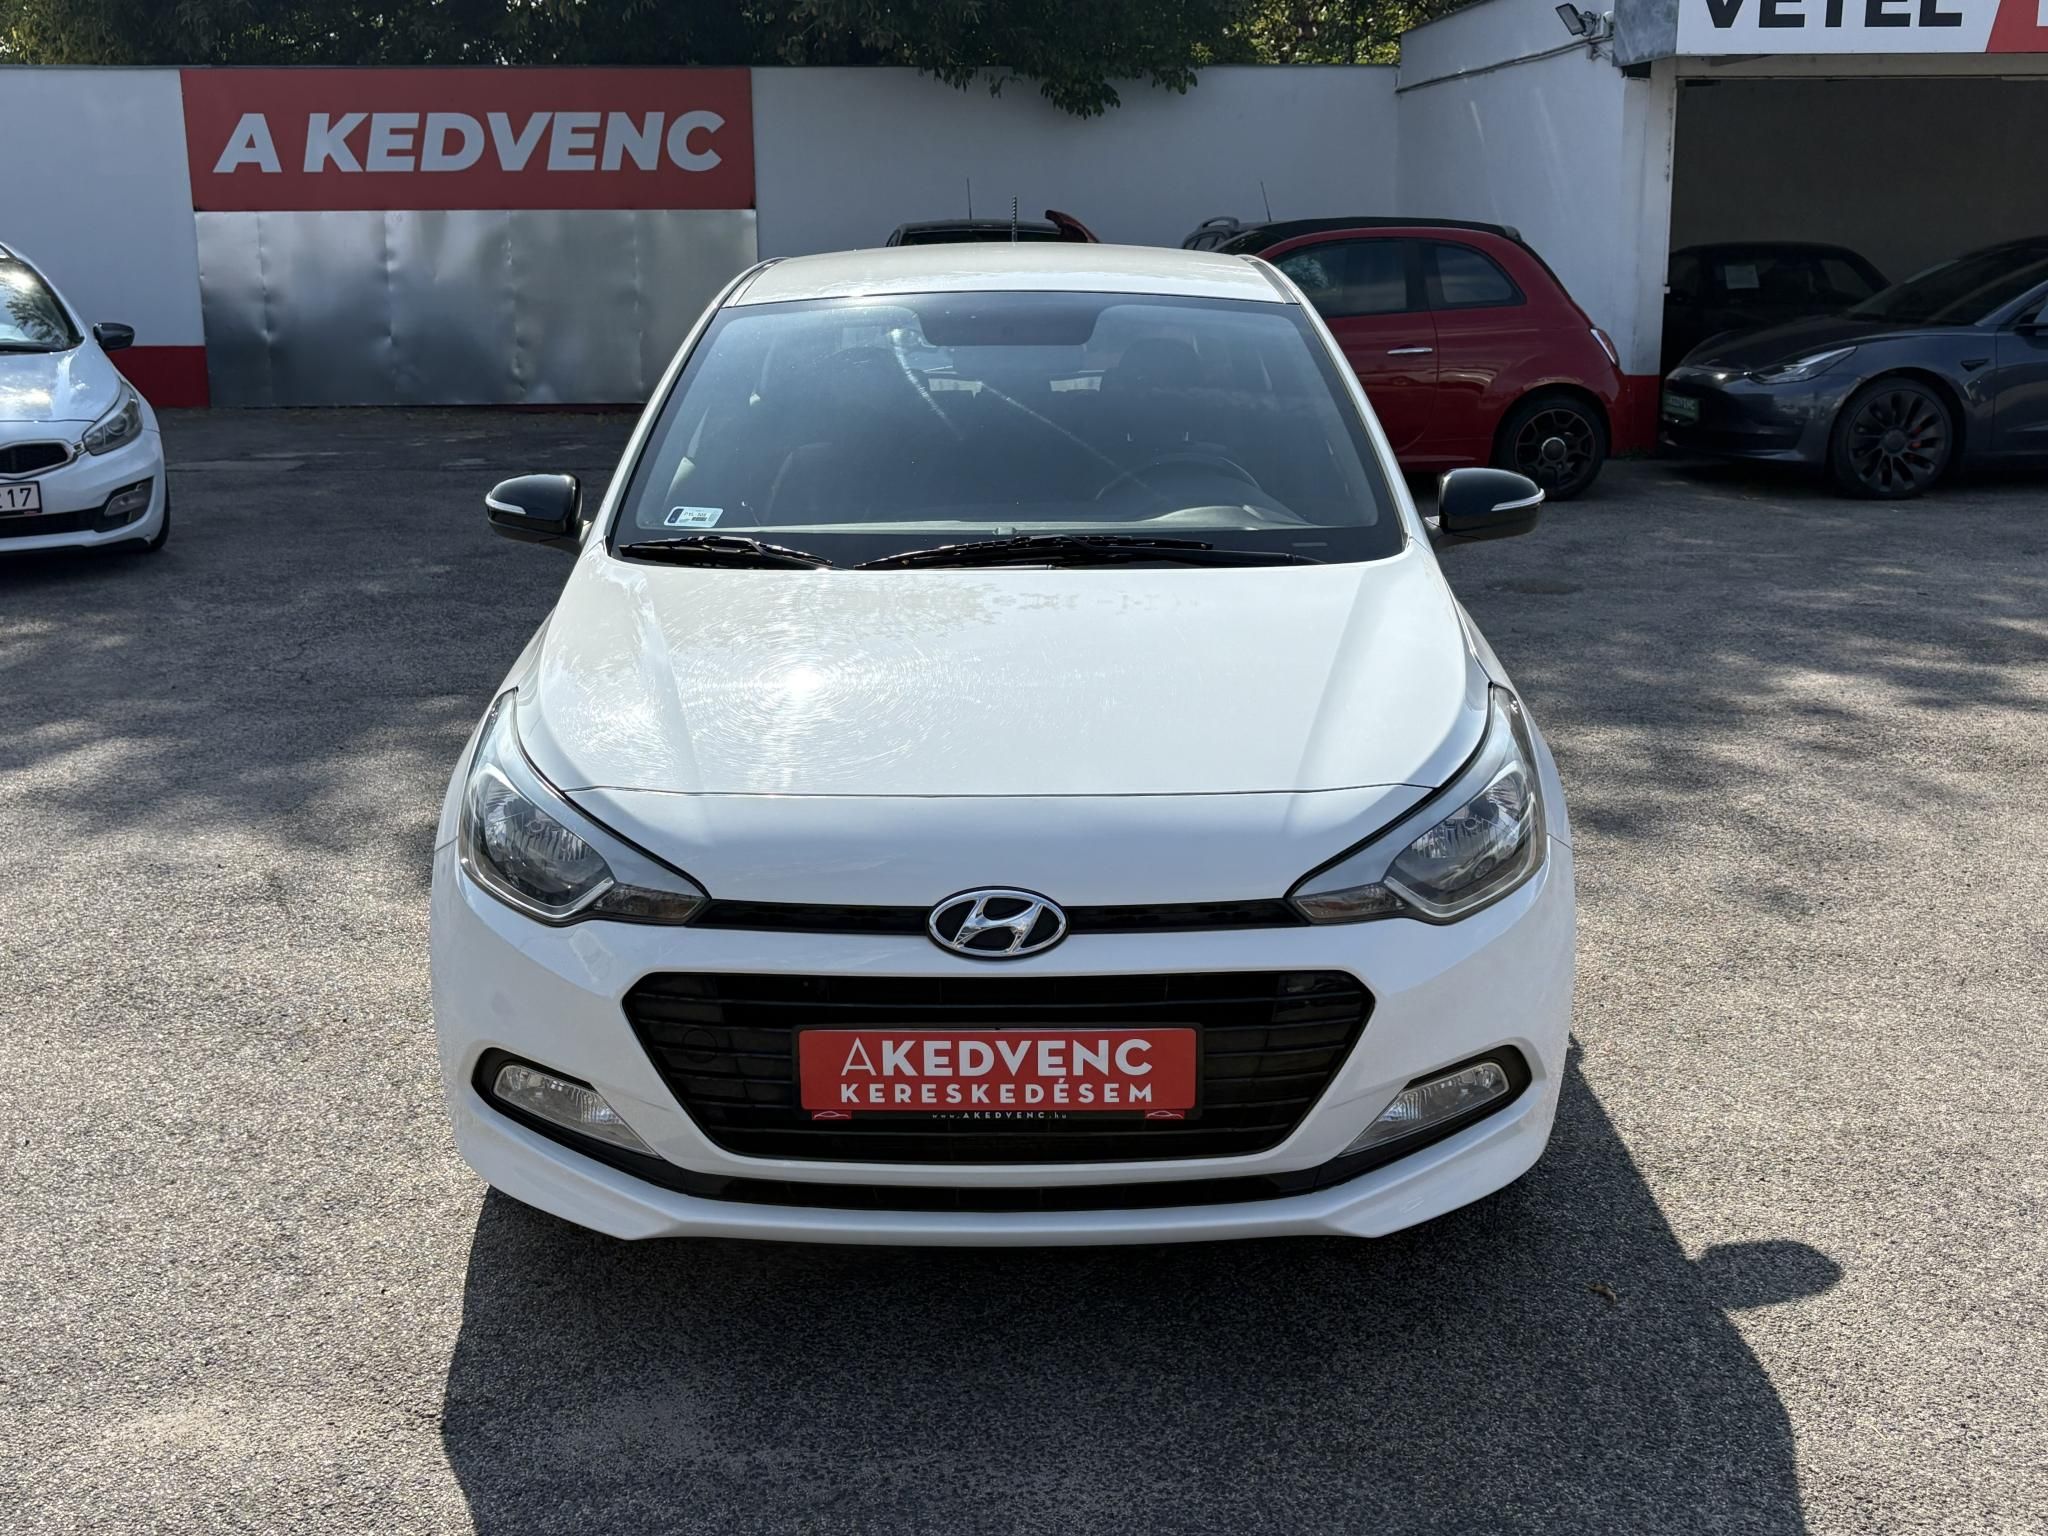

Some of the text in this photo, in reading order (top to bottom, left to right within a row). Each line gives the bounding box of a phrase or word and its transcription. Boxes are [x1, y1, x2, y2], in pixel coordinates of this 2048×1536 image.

[213, 111, 725, 173] A KEDVENC
[0, 487, 31, 507] 17
[841, 1078, 1152, 1103] KERESKEDÉSEM
